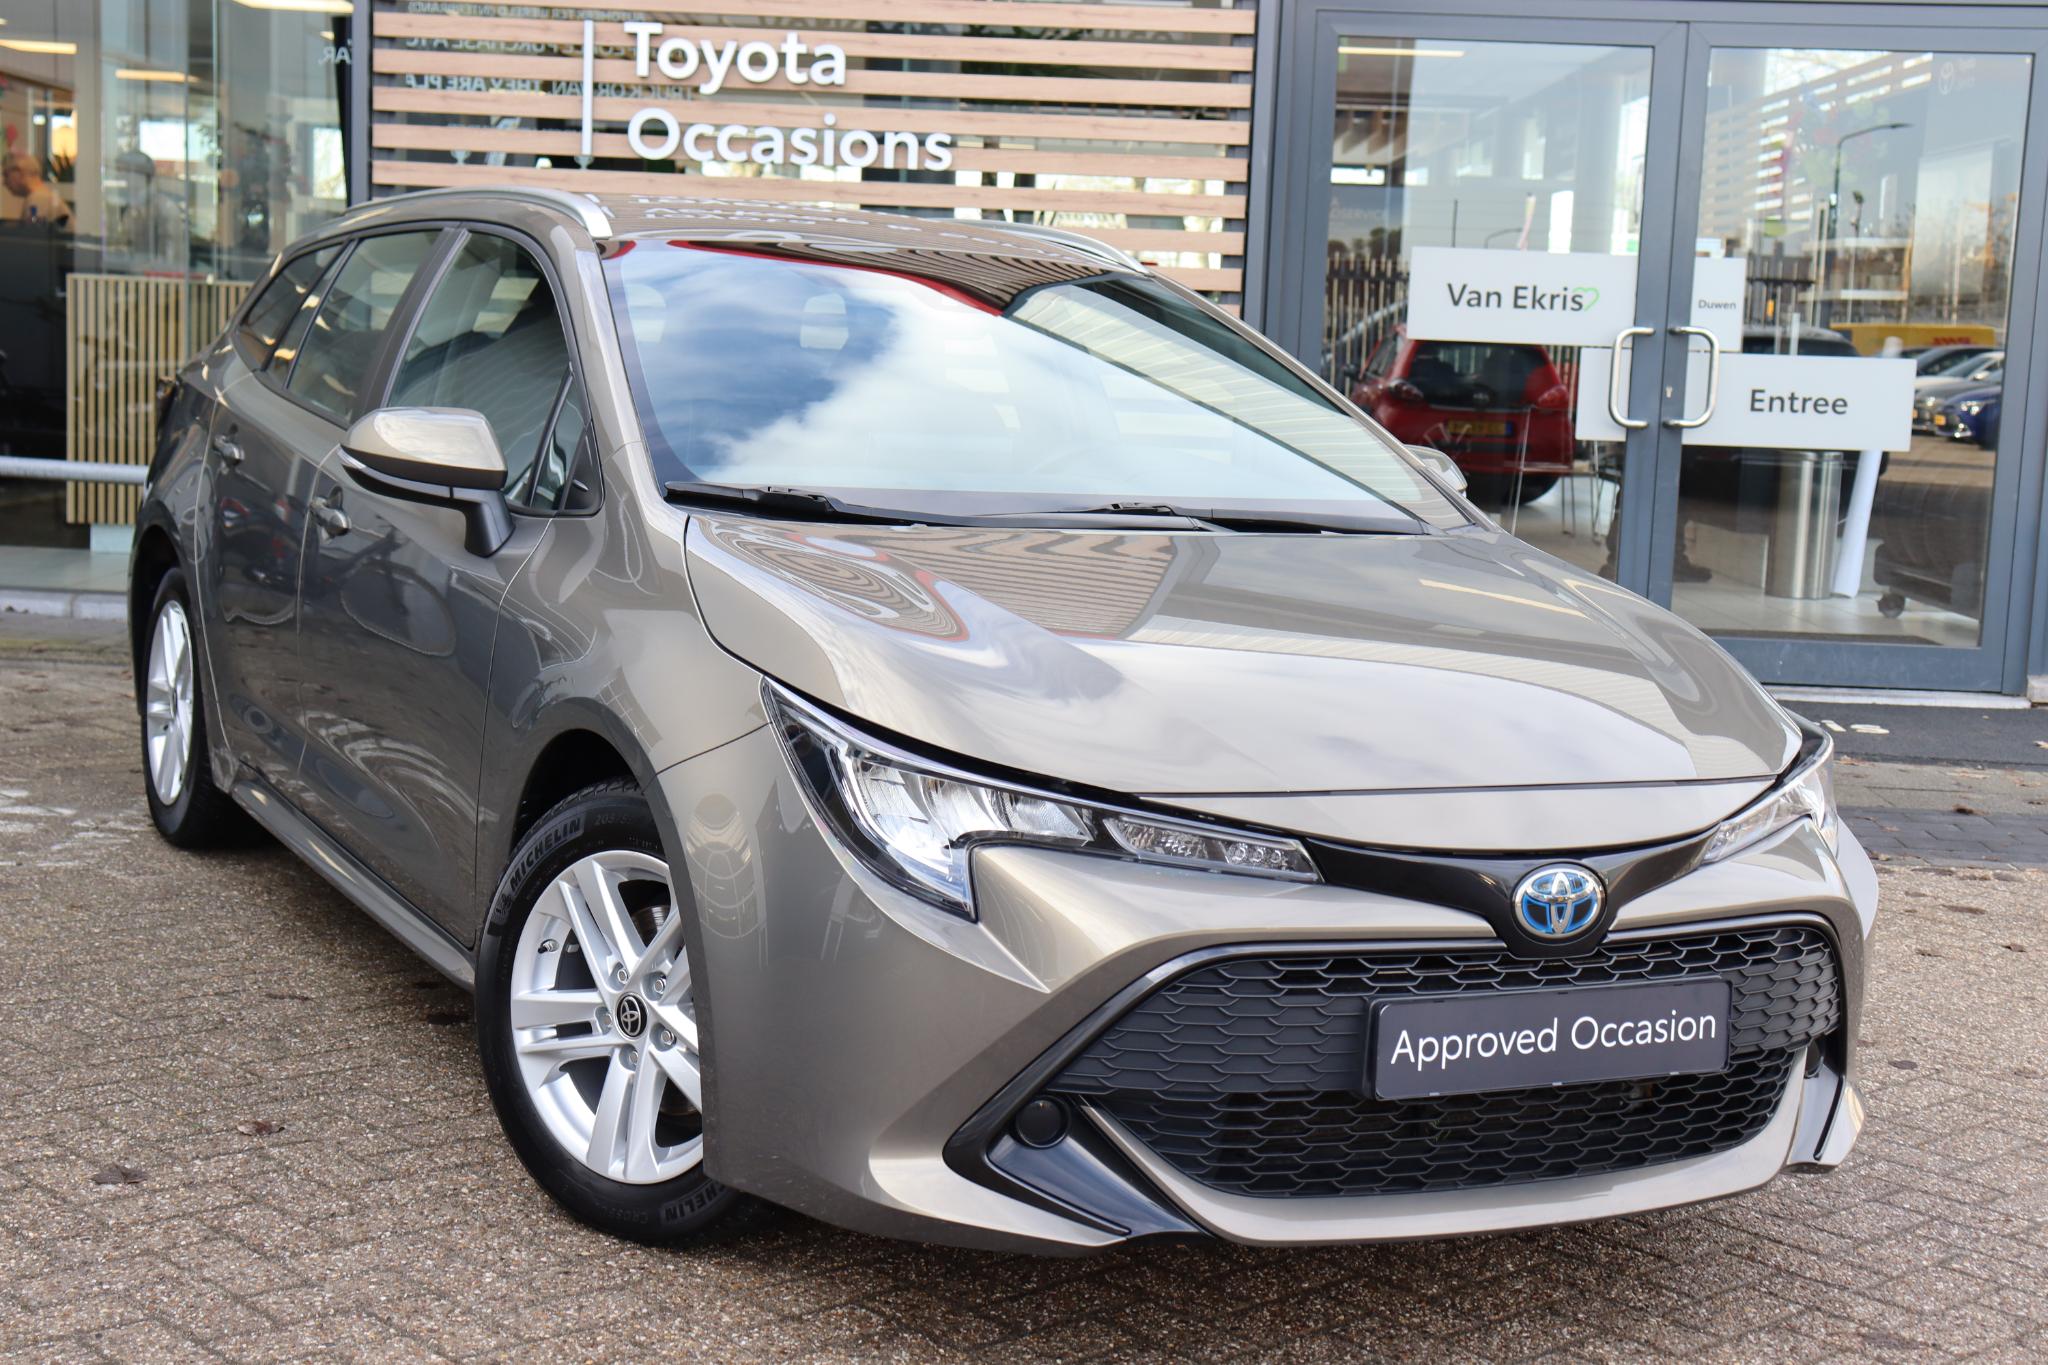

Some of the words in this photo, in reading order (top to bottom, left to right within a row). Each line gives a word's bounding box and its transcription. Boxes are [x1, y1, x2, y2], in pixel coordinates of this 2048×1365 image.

[624, 22, 847, 95] Toyota
[628, 108, 953, 171] Occasions
[1448, 283, 1502, 309] Van
[1513, 286, 1584, 311] Ekris
[1698, 299, 1737, 310] Duwen
[1750, 389, 1849, 415] Entree
[510, 817, 581, 892] MICHELIN
[1391, 1017, 1558, 1071] Approved
[1571, 1010, 1716, 1050] Occasion
